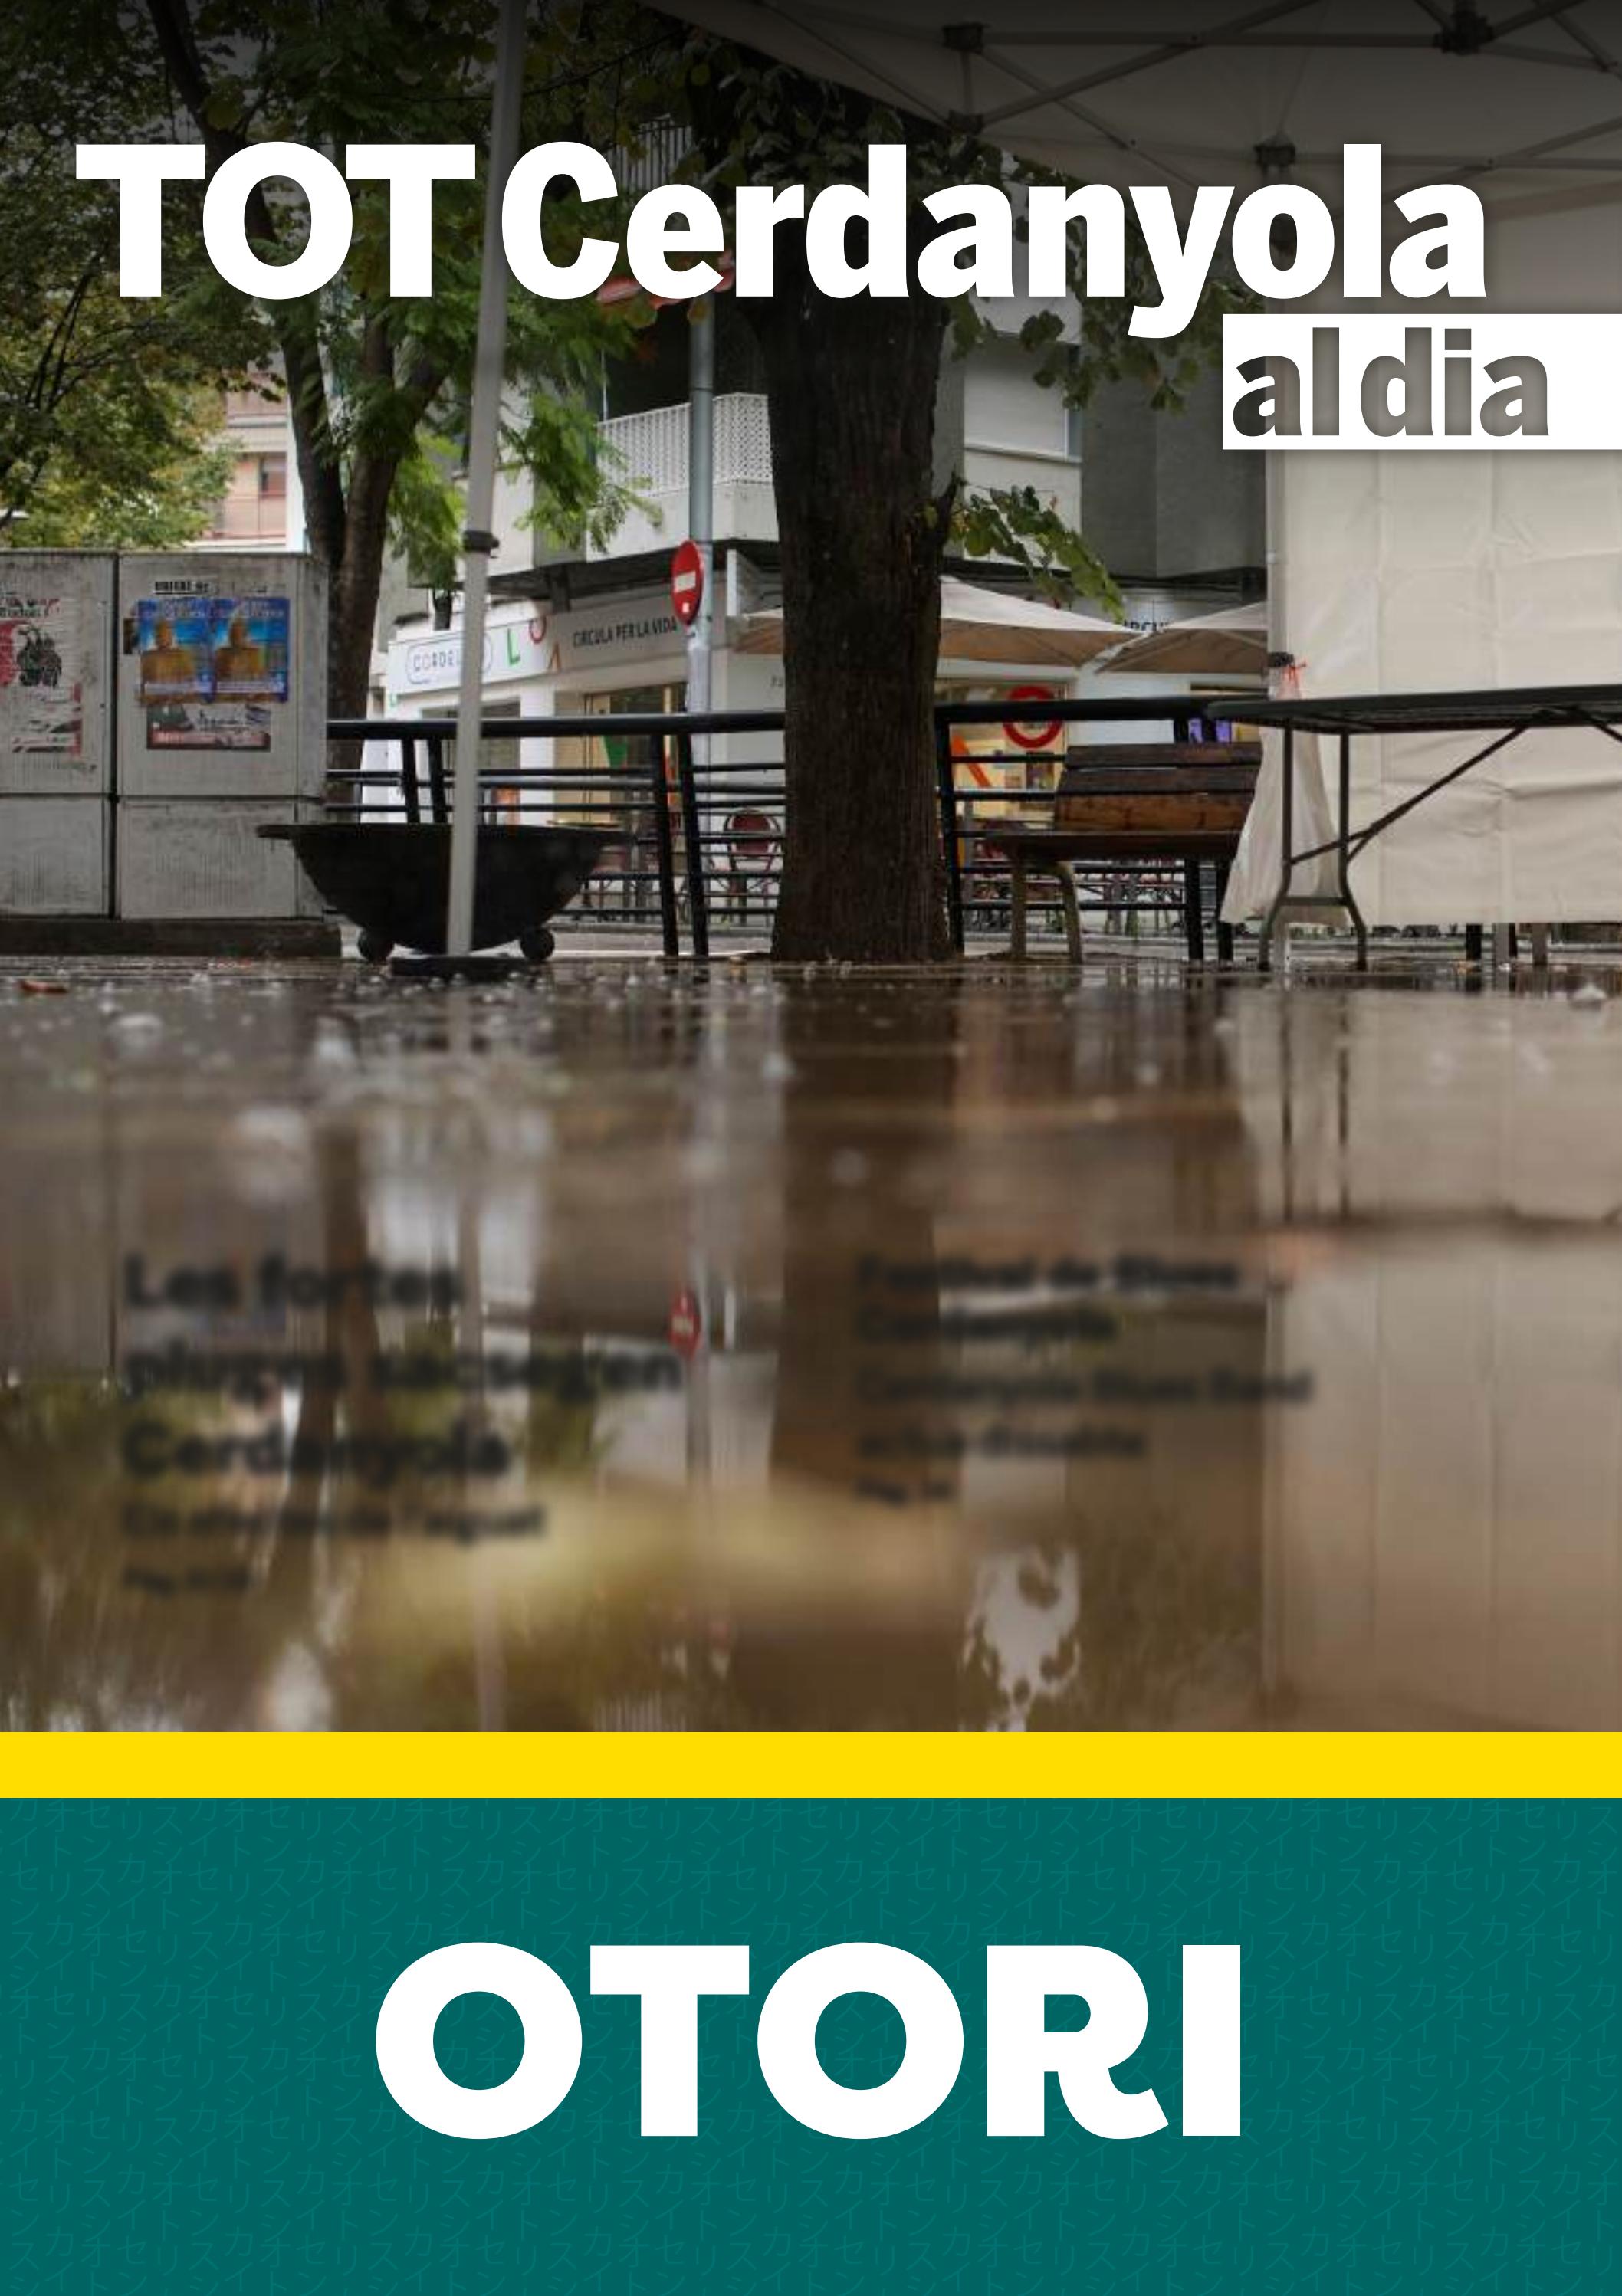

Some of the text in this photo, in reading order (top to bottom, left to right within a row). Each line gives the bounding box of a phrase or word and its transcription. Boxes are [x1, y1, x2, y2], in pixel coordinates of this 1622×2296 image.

[573, 615, 677, 646] CIRCULA PER LA VIDA
